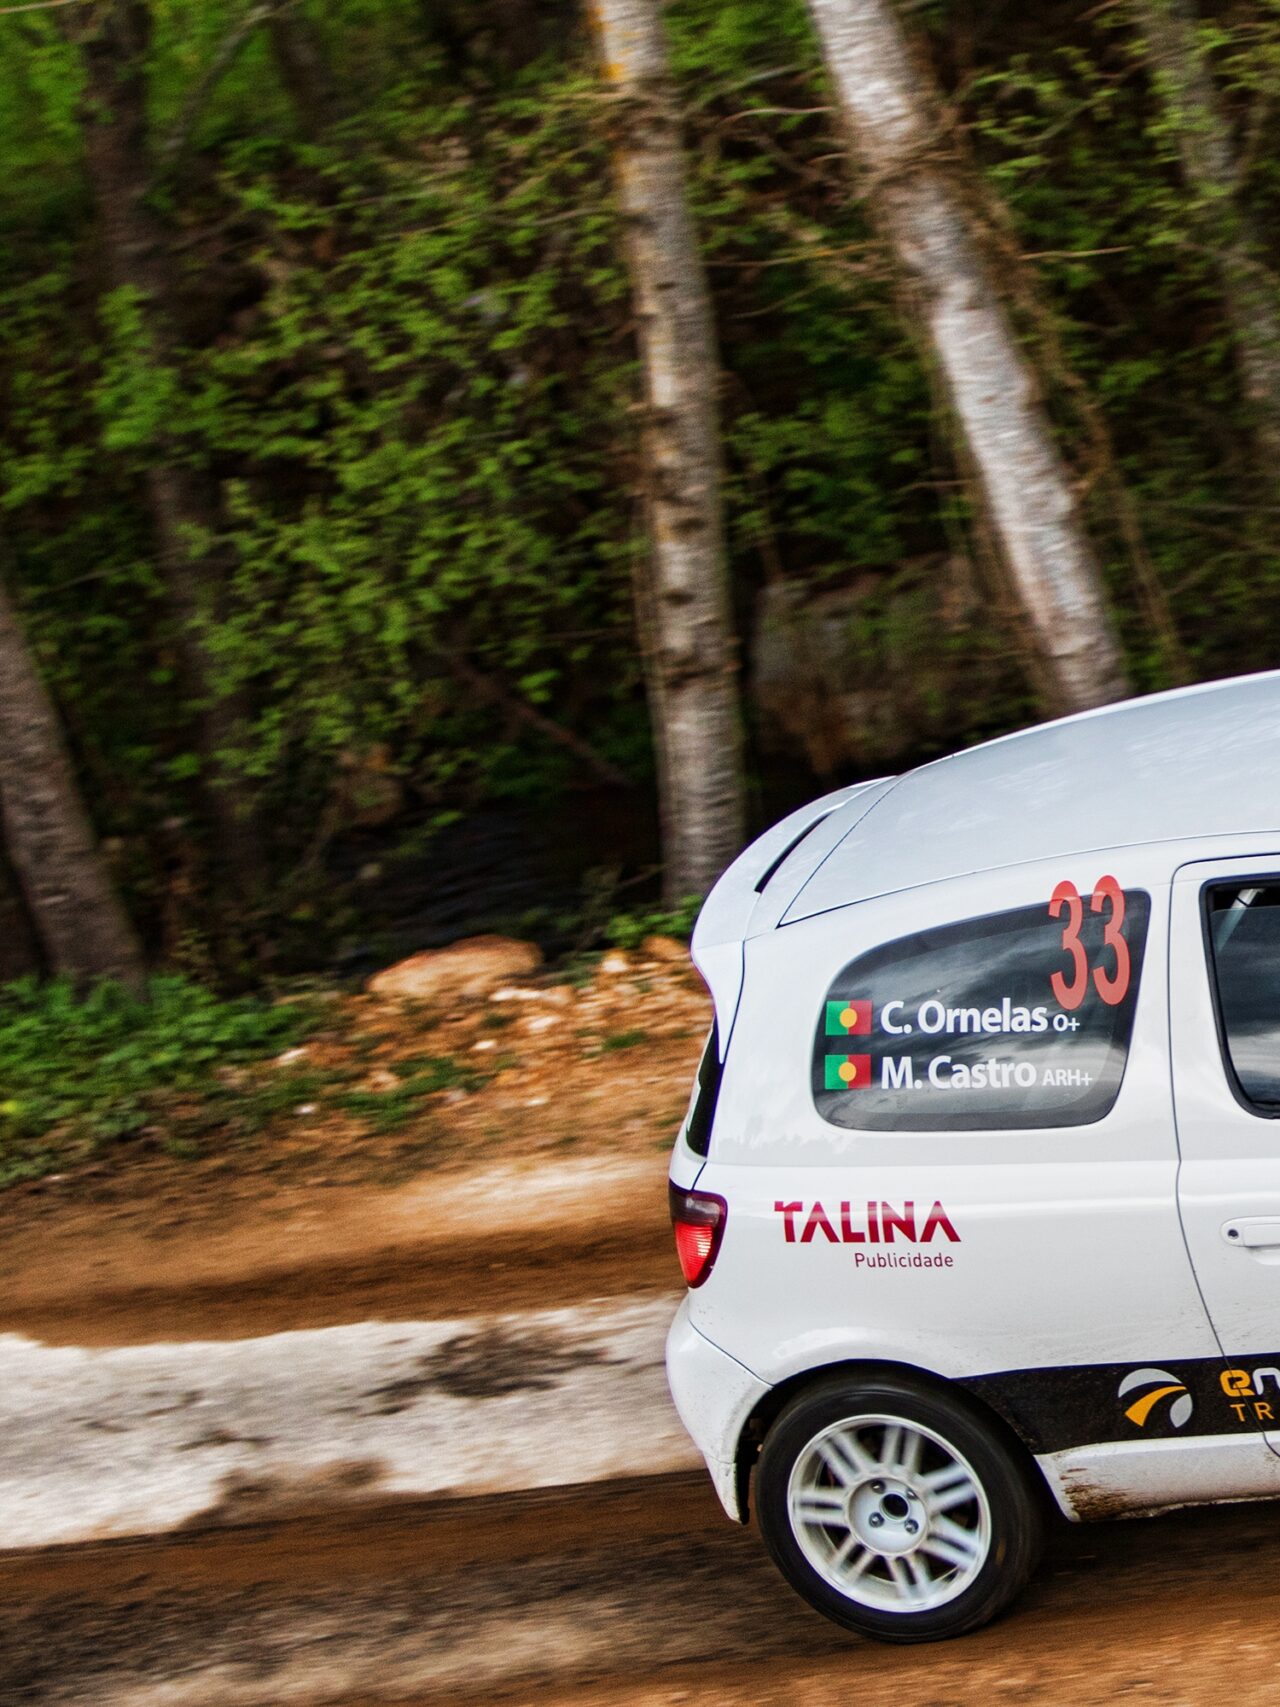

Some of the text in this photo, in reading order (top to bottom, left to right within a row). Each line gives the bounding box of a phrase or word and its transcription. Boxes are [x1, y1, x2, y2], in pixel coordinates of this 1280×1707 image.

[1047, 875, 1130, 1010] 33
[880, 997, 1080, 1034] C. Ornelas O+
[881, 1055, 1093, 1089] M. Castro ARH+
[774, 1200, 961, 1243] TALINA
[854, 1252, 954, 1268] Publicidade
